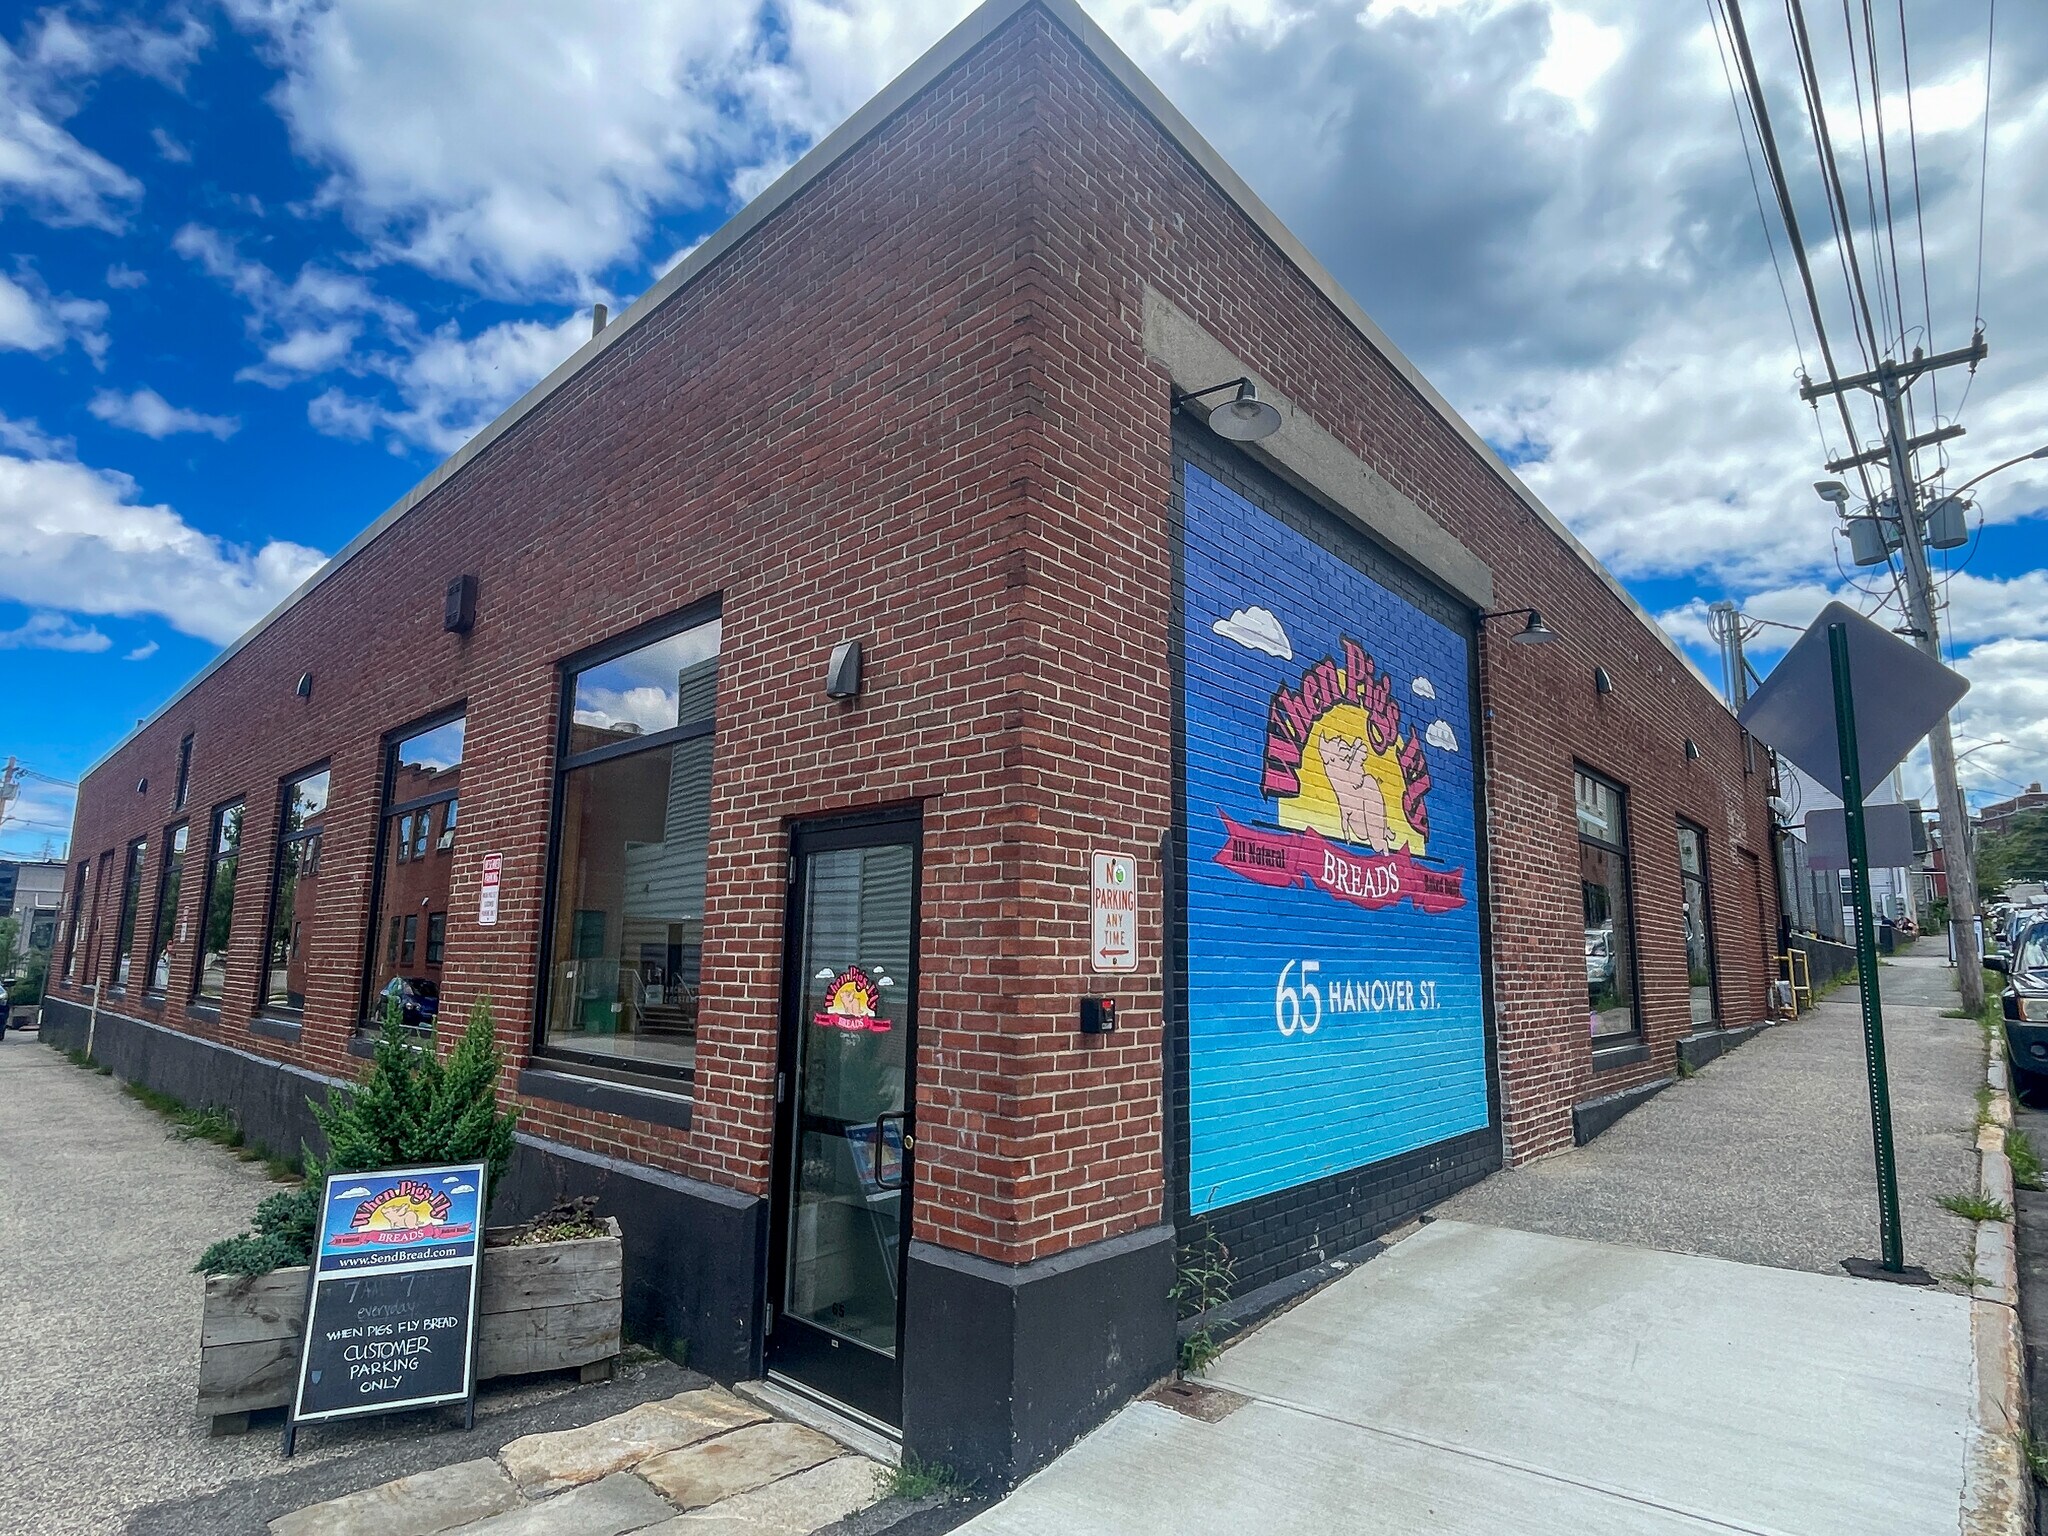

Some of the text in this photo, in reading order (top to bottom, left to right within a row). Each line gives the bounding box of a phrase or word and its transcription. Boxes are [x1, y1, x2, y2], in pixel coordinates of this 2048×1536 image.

[1261, 654, 1341, 801] When
[1232, 839, 1286, 869] All Natural
[1322, 850, 1399, 898] BREADS
[1096, 888, 1134, 911] PARKING
[1106, 914, 1123, 928] ANY
[1105, 931, 1125, 946] TIME
[1276, 959, 1441, 1036] 65 HANOVER ST.
[838, 1017, 864, 1029] BREADS
[350, 1188, 397, 1228] When
[428, 1191, 452, 1221] Fly
[378, 1230, 424, 1243] BREADS
[339, 1247, 457, 1267] www.SendBread.com
[357, 1300, 416, 1319] everyday
[326, 1316, 459, 1341] WHEN PIGS FLY BREAD
[343, 1335, 432, 1361] CUSTOMER
[350, 1357, 419, 1380] PARKING
[360, 1375, 402, 1393] ONLY
